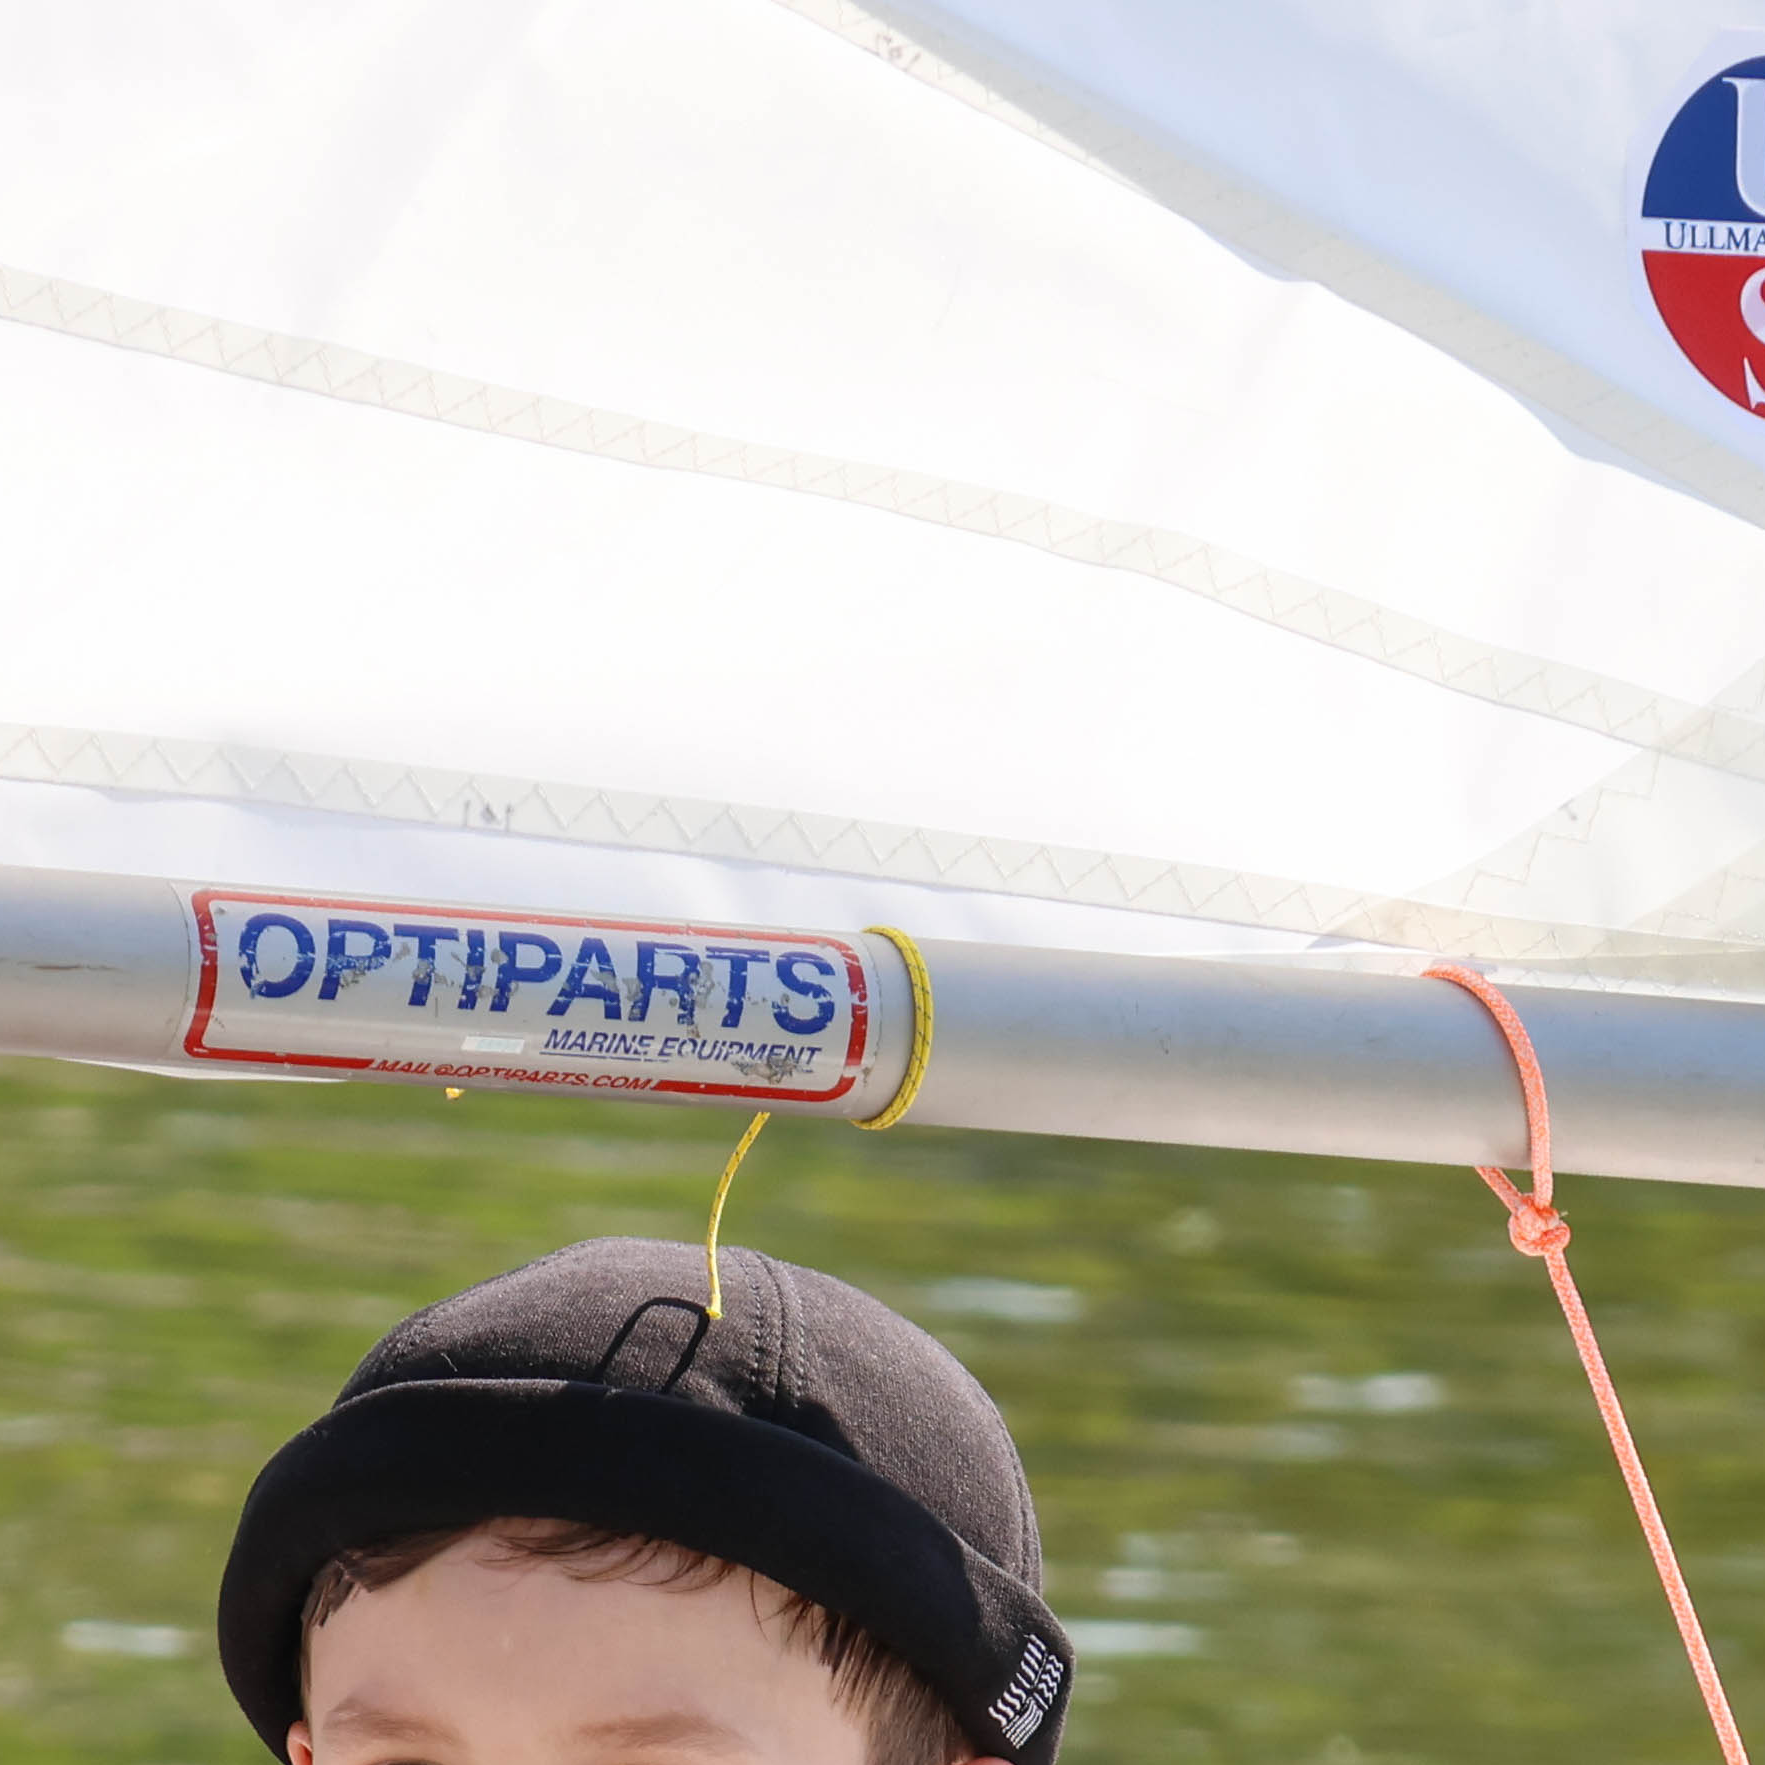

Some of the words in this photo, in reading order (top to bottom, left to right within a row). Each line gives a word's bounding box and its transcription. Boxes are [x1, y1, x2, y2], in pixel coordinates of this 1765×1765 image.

[238, 911, 836, 1036] OPTIPARTS
[544, 1028, 654, 1057] MARINE
[658, 1036, 822, 1066] EQUIPMENT
